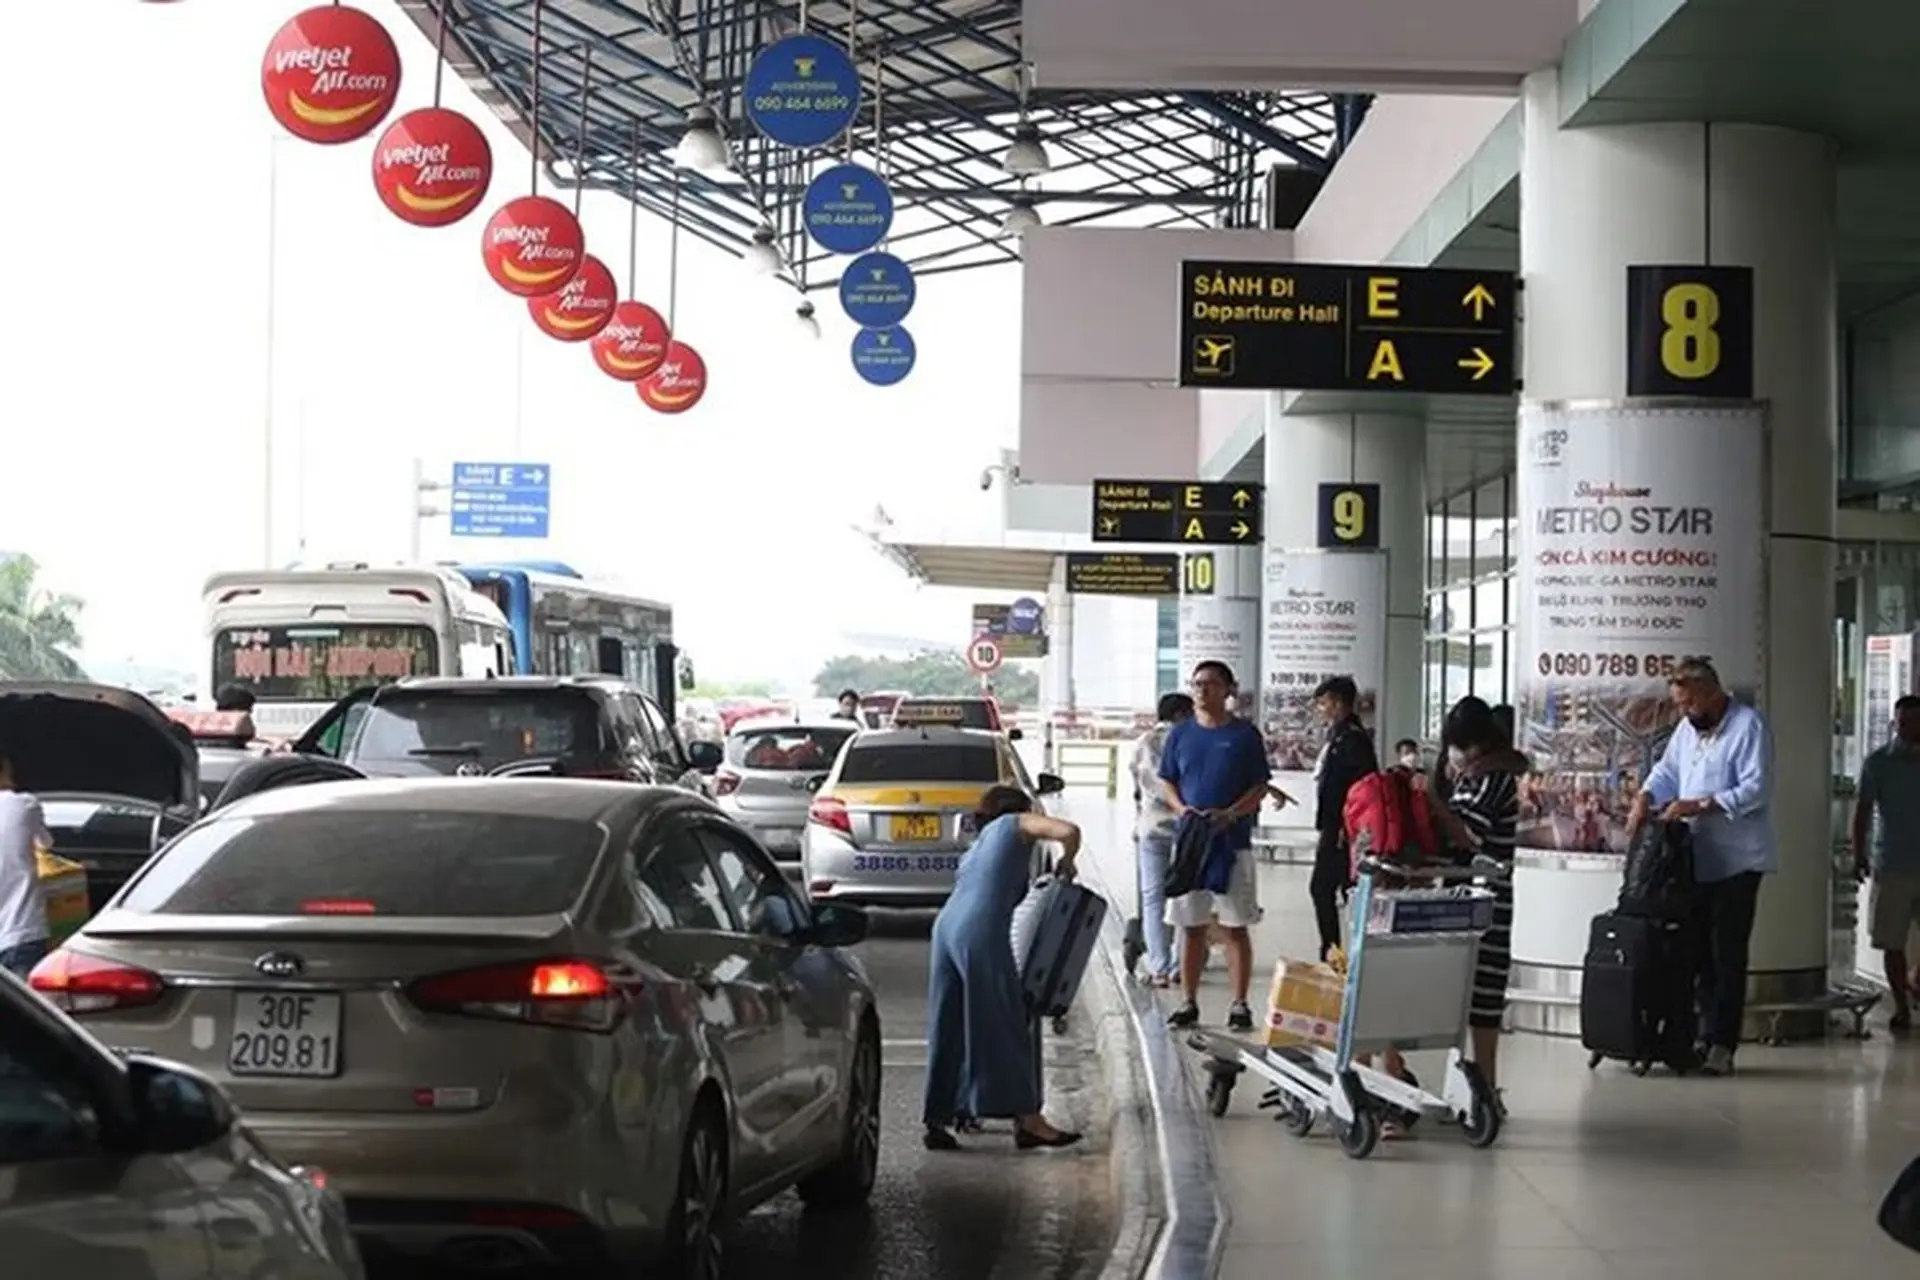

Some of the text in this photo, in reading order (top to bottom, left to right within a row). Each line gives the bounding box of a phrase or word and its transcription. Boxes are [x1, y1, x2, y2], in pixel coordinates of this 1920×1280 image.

[754, 96, 781, 111] 090
[786, 96, 811, 110] 464
[1194, 269, 1295, 297] SẢNH ĐI
[1368, 277, 1398, 318] E
[1193, 301, 1339, 323] Departure Hall
[1661, 283, 1720, 378] 8
[1366, 340, 1404, 380] A
[1184, 486, 1203, 508] E
[1184, 517, 1205, 540] A
[1332, 491, 1366, 540] 9
[1629, 506, 1714, 536] STAR
[1186, 557, 1211, 590] 10
[977, 645, 994, 663] 10
[1554, 653, 1591, 676] 090
[1595, 653, 1639, 677] 789
[259, 995, 317, 1030] 30F
[233, 1033, 332, 1069] 209.81
